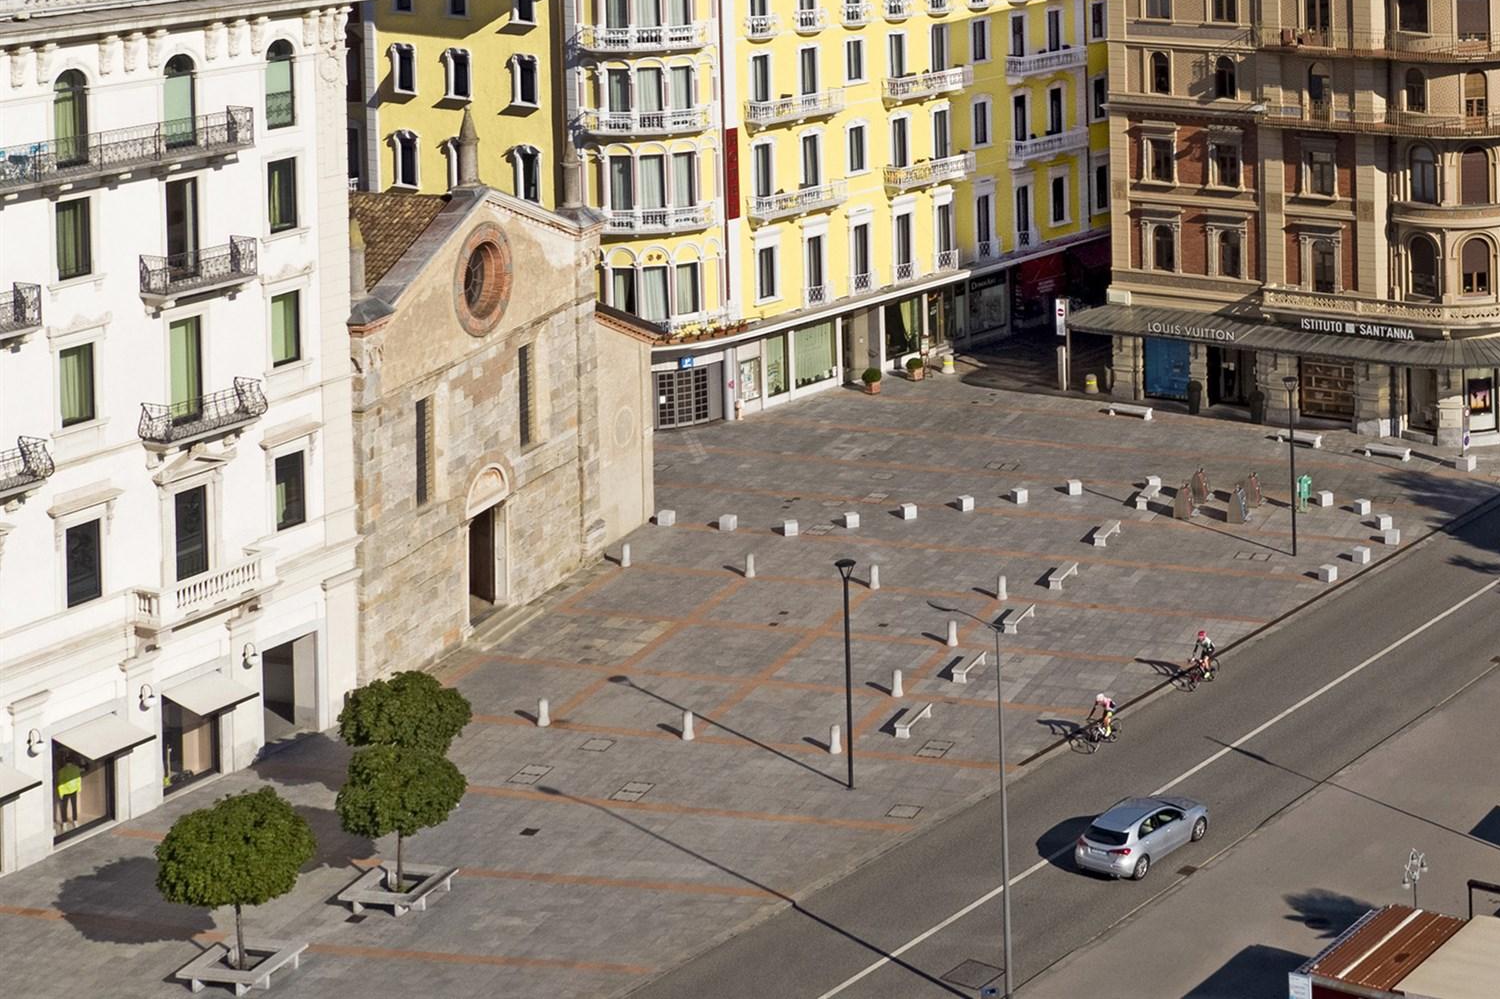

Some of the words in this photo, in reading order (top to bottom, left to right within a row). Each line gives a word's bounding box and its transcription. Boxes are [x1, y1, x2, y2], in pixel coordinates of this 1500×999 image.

[1147, 322, 1181, 335] LOUIS
[1184, 326, 1235, 341] VUITTON
[1300, 317, 1342, 333] ISTITUTO
[1359, 323, 1415, 341] SANT'ANNA
